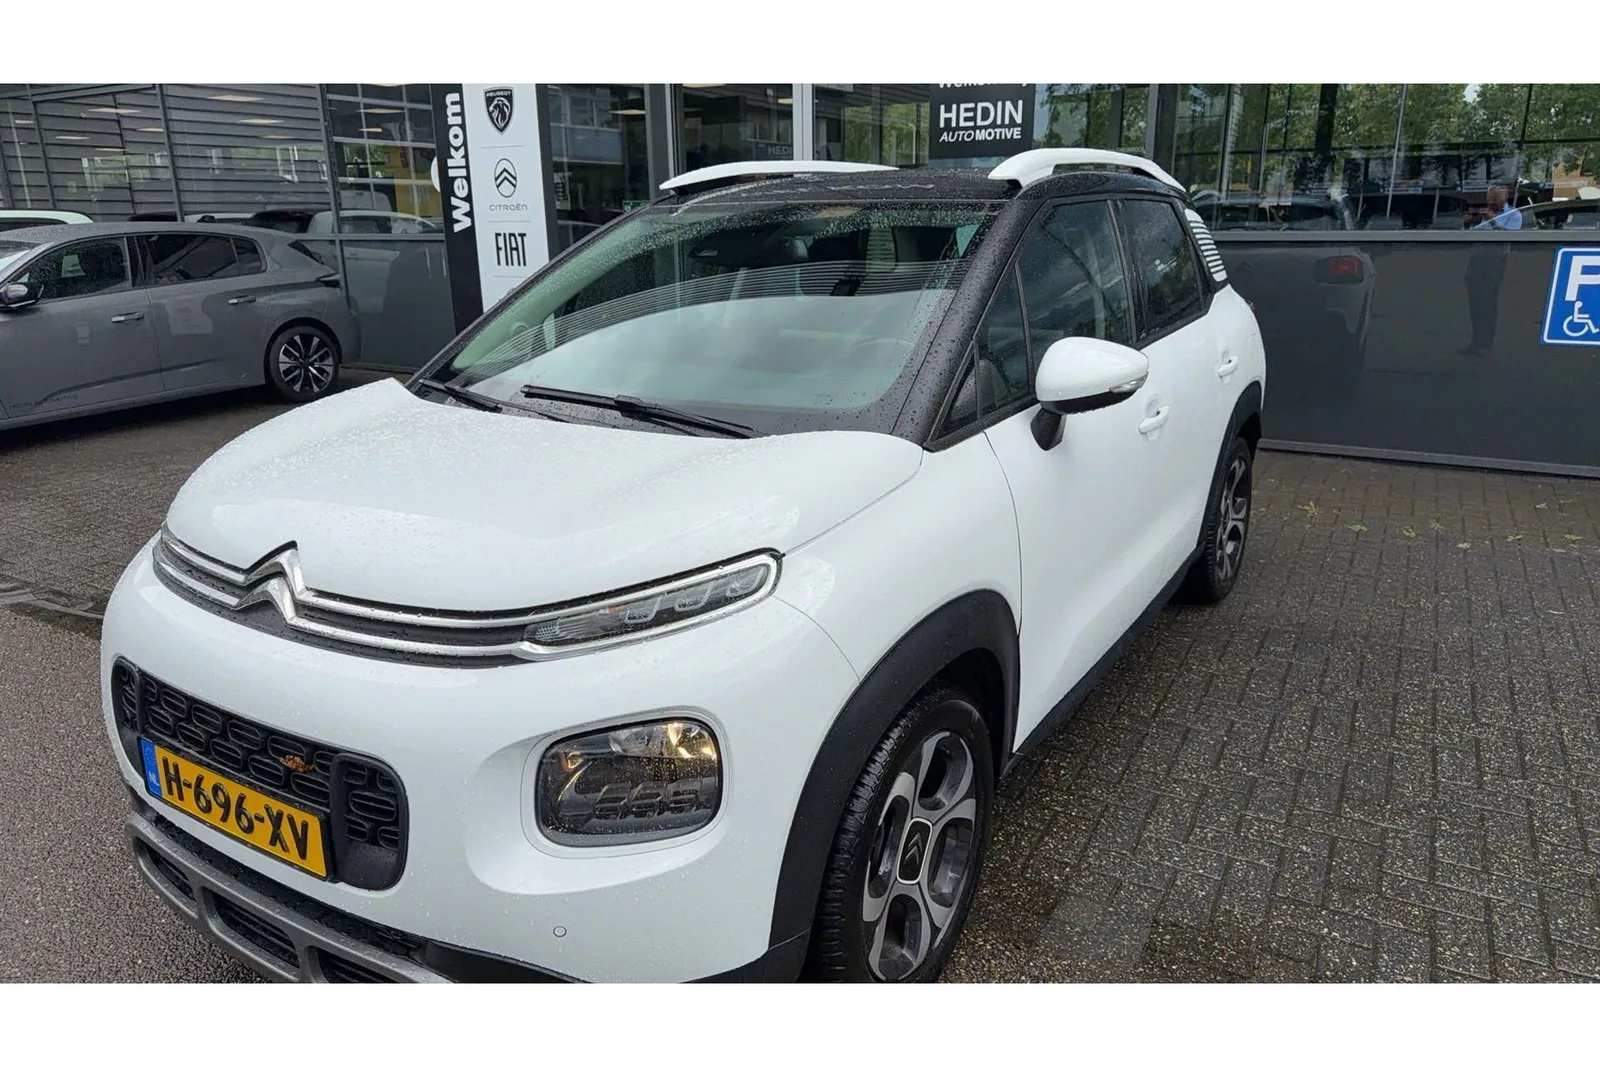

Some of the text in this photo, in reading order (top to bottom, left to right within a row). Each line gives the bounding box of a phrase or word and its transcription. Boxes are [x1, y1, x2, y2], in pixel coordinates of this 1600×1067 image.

[939, 100, 1023, 128] HEDIN
[767, 145, 792, 155] HEDI
[939, 127, 1022, 143] AUTOMOTIVE
[445, 92, 472, 233] Welkom
[494, 232, 527, 267] FIAT
[1564, 255, 1600, 301] P
[148, 770, 160, 787] NL
[161, 756, 309, 860] H-696-XV
